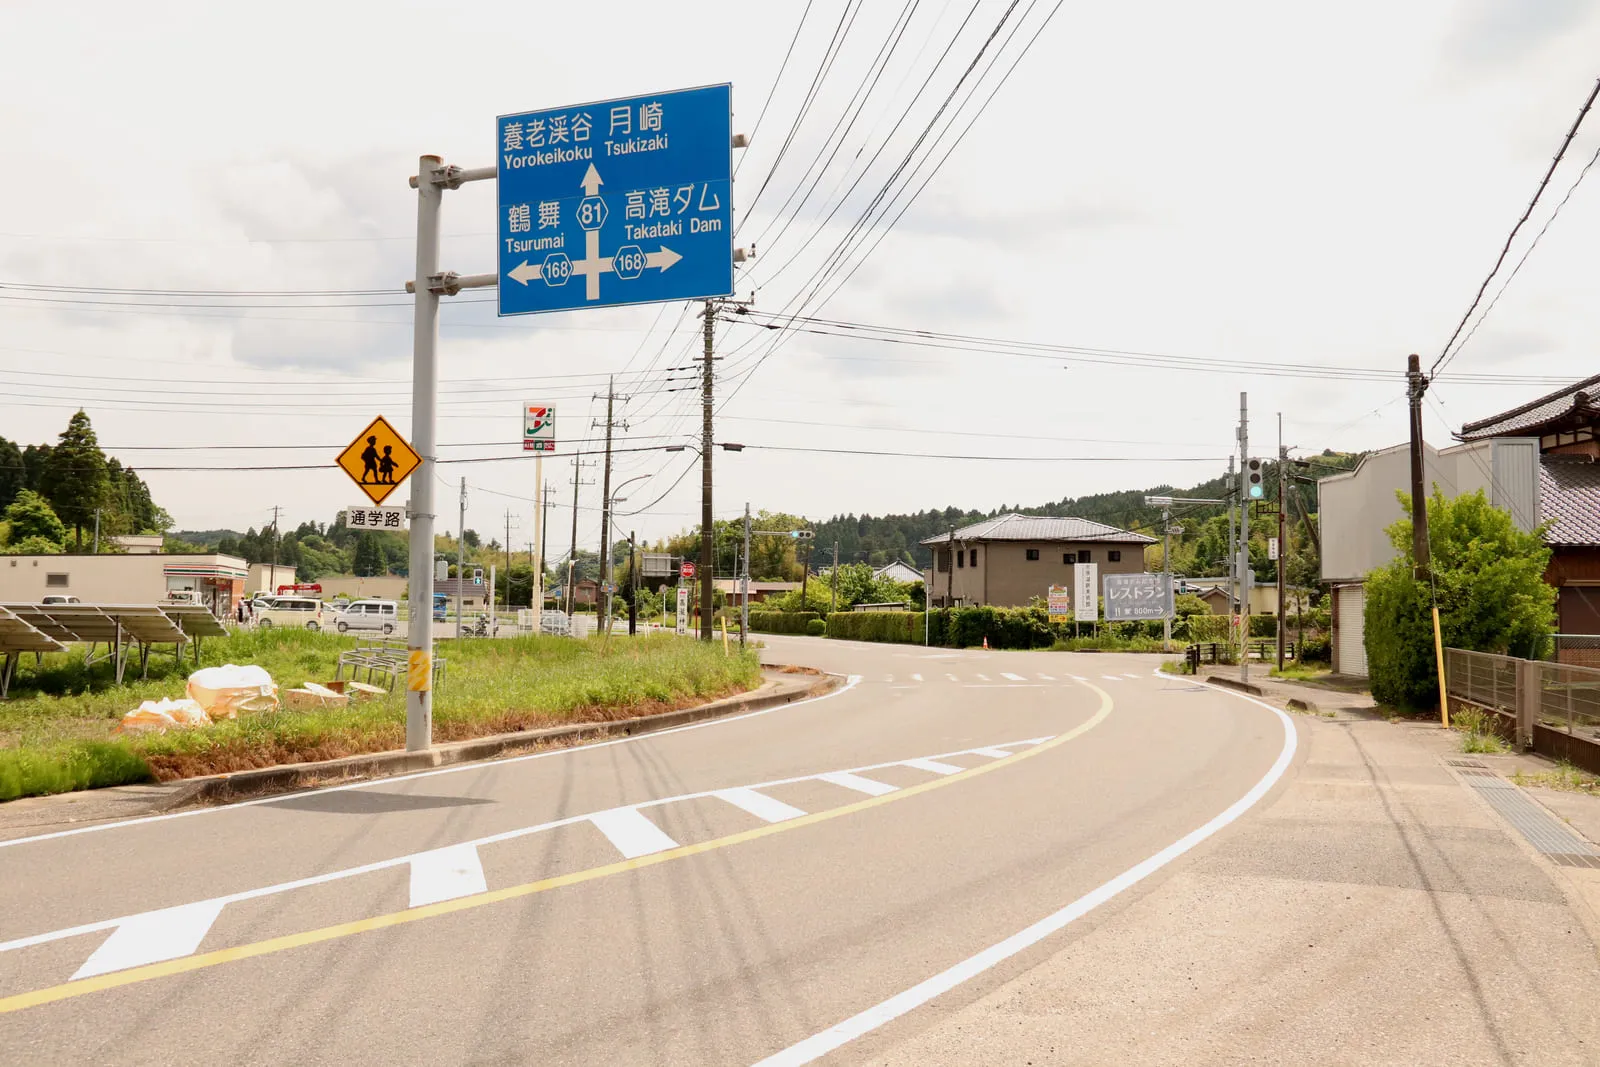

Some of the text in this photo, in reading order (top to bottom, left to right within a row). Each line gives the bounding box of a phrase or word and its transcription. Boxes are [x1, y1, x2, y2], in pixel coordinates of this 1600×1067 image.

[609, 101, 664, 137] 月崎
[503, 112, 593, 151] 養老渓谷
[604, 133, 669, 157] Tsukizaki
[503, 145, 593, 170] Yorokeikoku
[581, 202, 602, 225] 81
[625, 183, 721, 221] 高滝ダム
[508, 201, 561, 234] 鶴舞
[624, 216, 722, 241] Takataki Dam
[505, 232, 565, 254] Tsurumai
[545, 260, 569, 279] 168
[618, 252, 642, 271] 168
[351, 510, 400, 527] 通学路
[1110, 586, 1165, 600] レストラン
